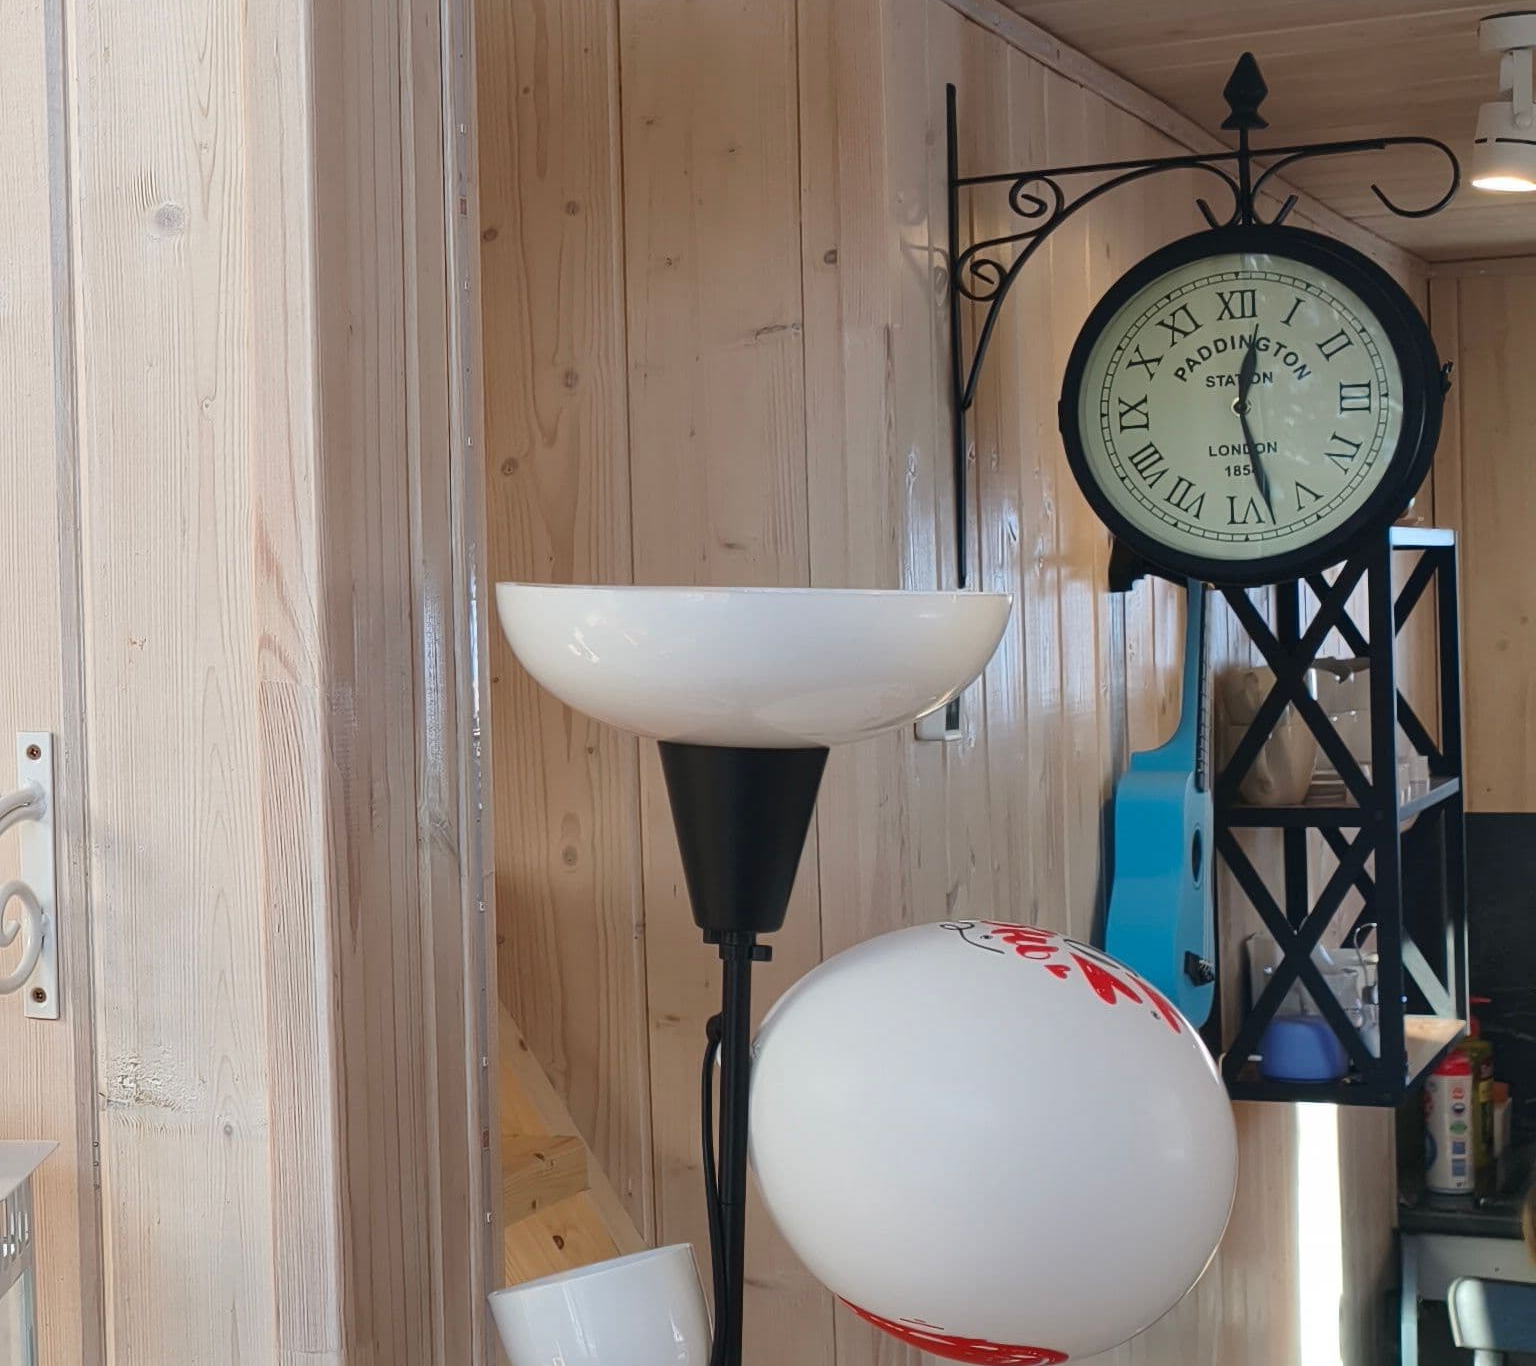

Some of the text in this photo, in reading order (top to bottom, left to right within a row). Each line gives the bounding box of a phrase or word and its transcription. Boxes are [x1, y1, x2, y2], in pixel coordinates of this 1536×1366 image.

[1216, 289, 1257, 321] XII
[1280, 297, 1306, 327] I
[1156, 302, 1204, 348] XI
[1126, 344, 1164, 381] X
[1173, 333, 1312, 382] PADDINGTON
[1317, 328, 1354, 362] II
[1205, 371, 1274, 388] STAON
[1339, 379, 1372, 415] III
[1118, 393, 1150, 434] IX
[1127, 441, 1171, 489] VIII
[1208, 441, 1278, 457] LONDON
[1324, 431, 1363, 475] IV
[1224, 464, 1257, 477] 185
[1163, 475, 1207, 520] VII
[1226, 495, 1266, 525] VI
[1294, 480, 1324, 512] V
